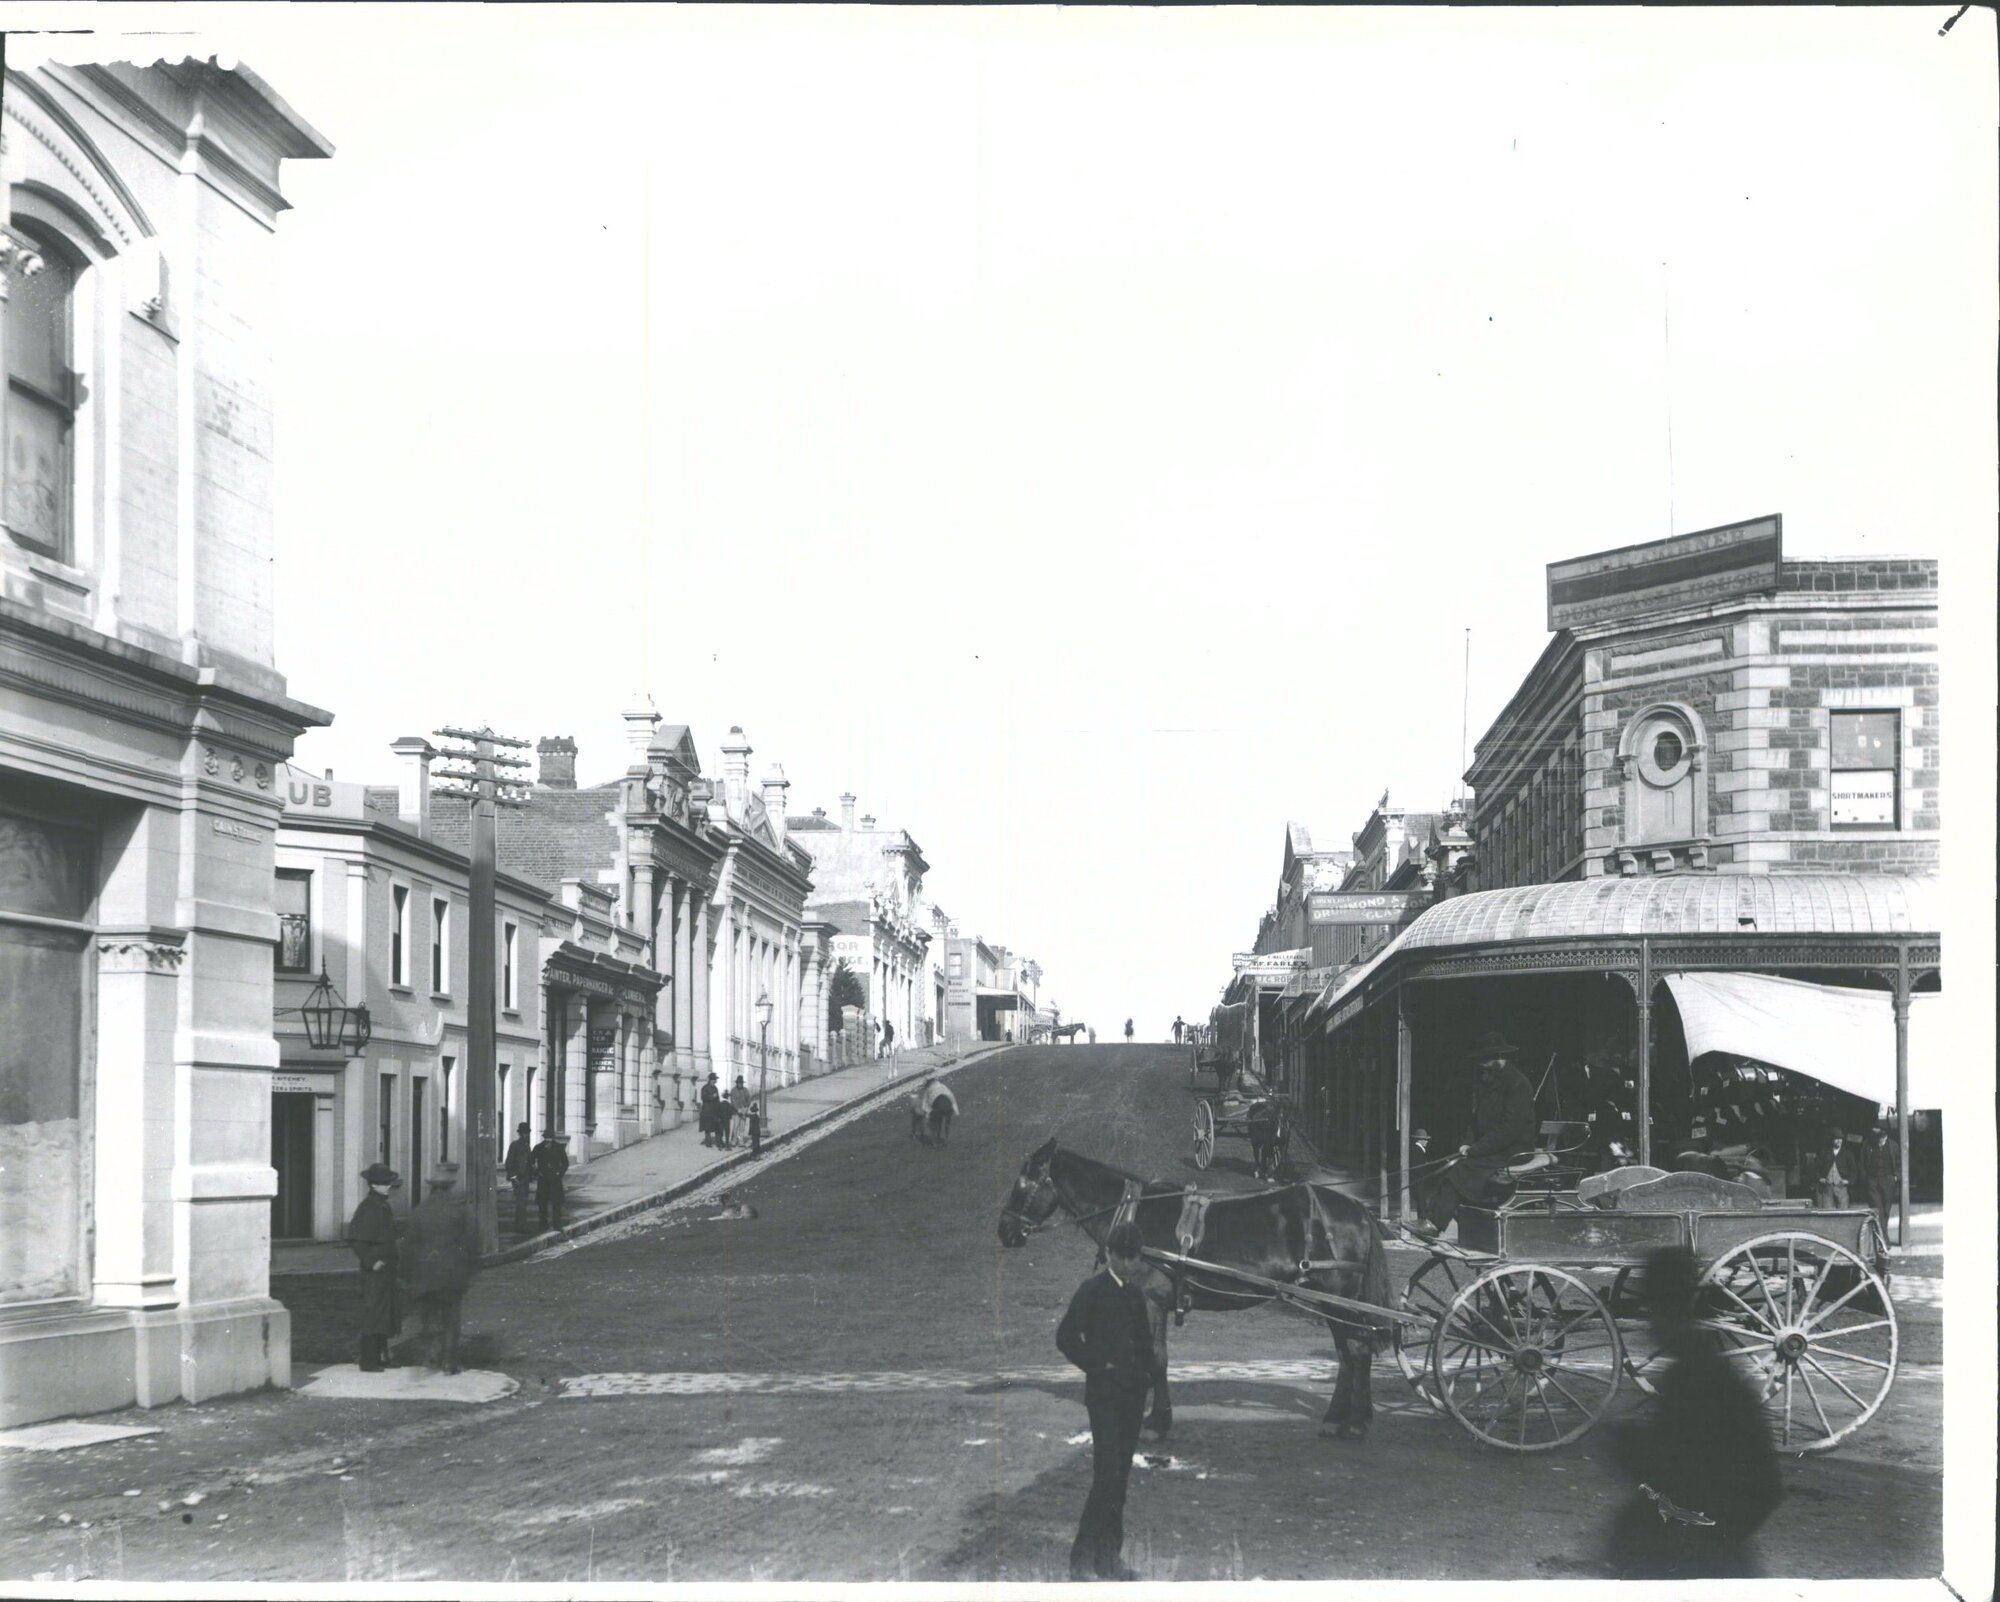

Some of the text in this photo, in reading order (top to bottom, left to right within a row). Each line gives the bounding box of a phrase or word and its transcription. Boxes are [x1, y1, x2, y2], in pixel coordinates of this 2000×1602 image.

[1559, 587, 1681, 623] DUNSTABLE
[1313, 896, 1385, 919] DRUMMOND
[1391, 895, 1399, 903] &
